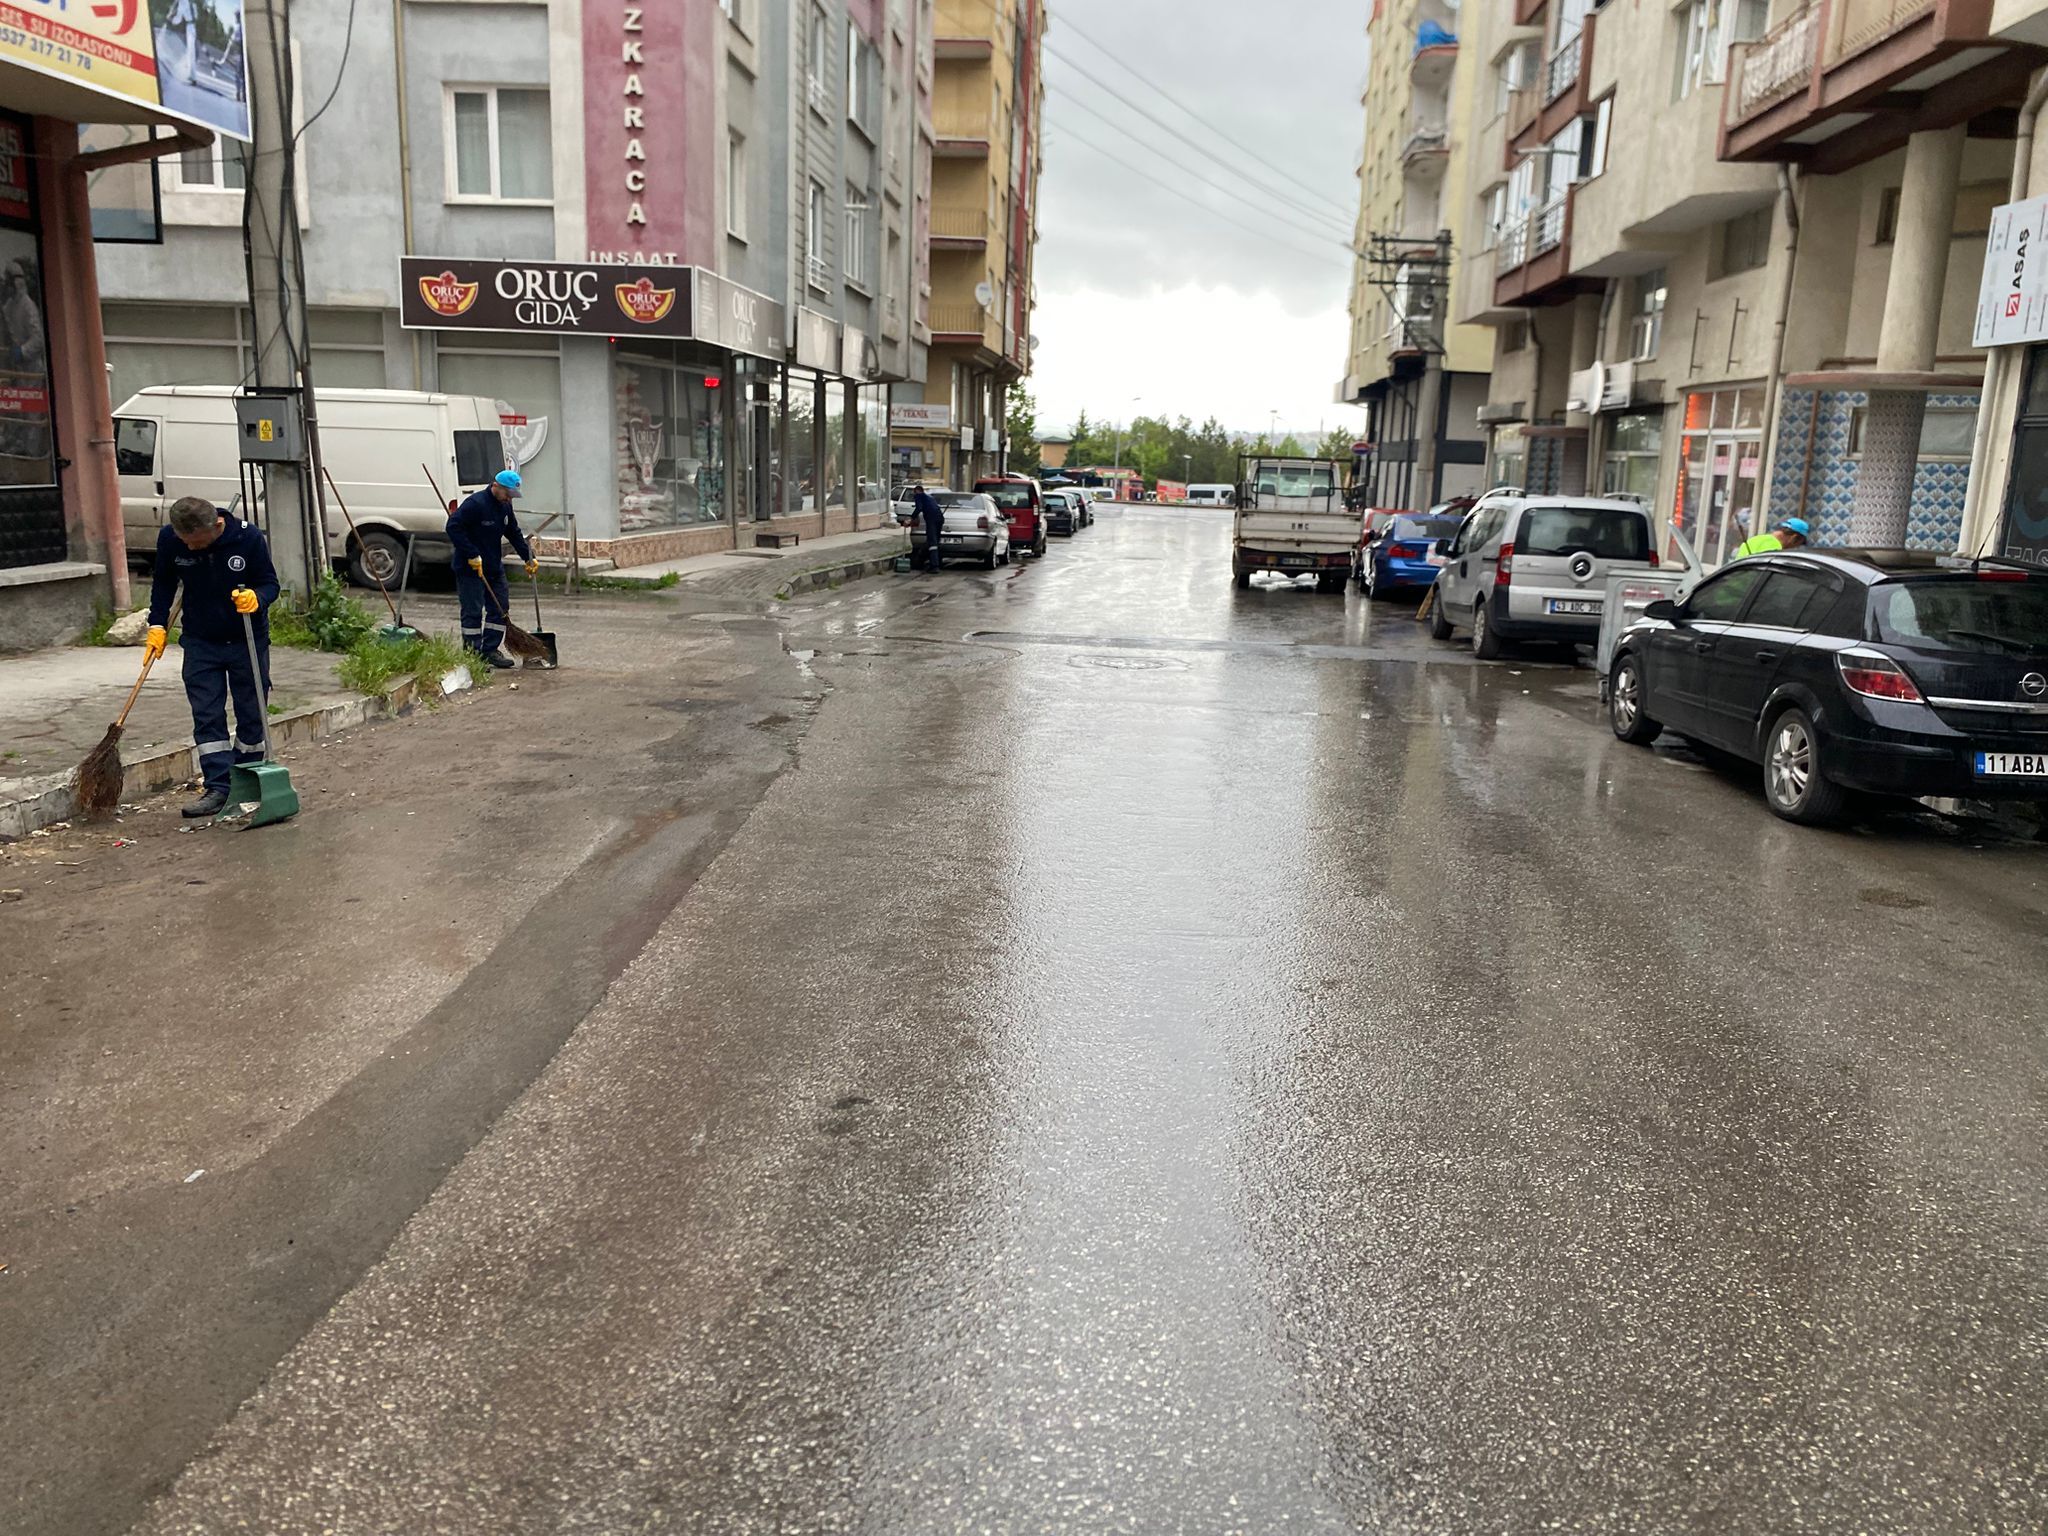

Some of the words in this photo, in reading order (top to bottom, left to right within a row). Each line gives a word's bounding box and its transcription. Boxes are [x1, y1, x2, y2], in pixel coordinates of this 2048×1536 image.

[30, 17, 48, 36] SU
[0, 27, 26, 48] 537
[31, 37, 54, 56] 317
[58, 47, 71, 63] 21
[76, 53, 92, 70] 78
[430, 285, 465, 300] ORUÇ
[495, 268, 598, 311] ORUÇ
[627, 292, 662, 307] ORUÇ
[515, 300, 581, 326] GIDA
